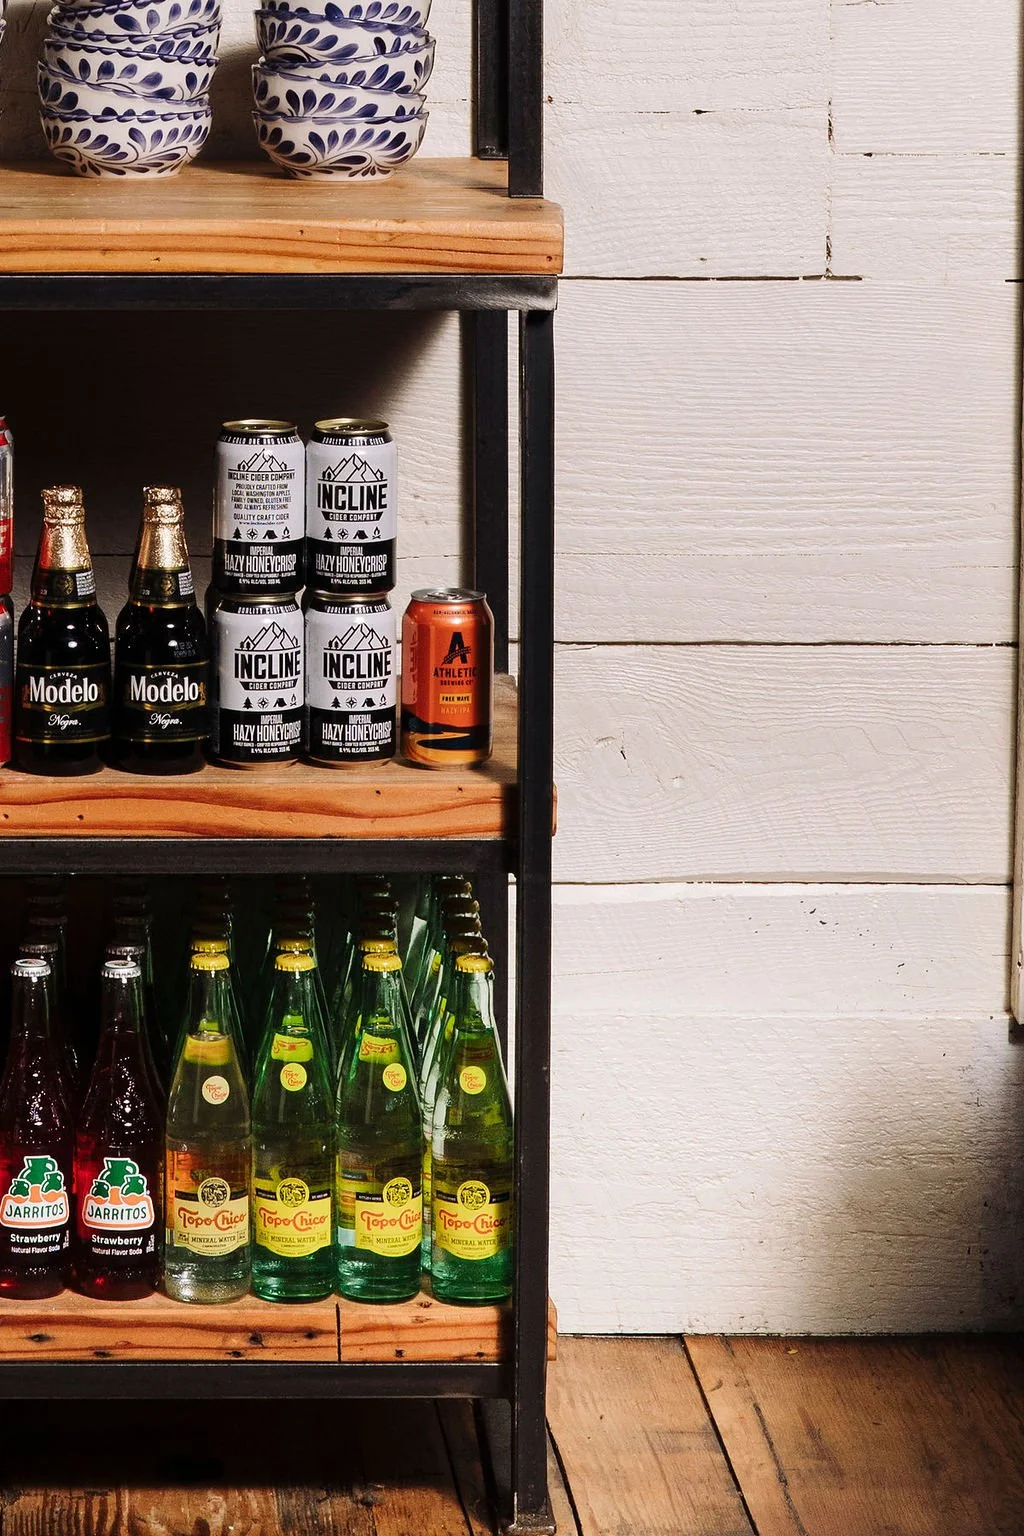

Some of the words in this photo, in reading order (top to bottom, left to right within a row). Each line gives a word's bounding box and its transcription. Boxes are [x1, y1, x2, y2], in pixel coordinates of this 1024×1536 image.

[228, 472, 249, 481] INCLINE
[271, 472, 295, 481] COMPANY
[318, 483, 387, 511] INCLINE
[250, 546, 273, 555] IMPERIAL
[340, 546, 363, 556] IMPERIAL
[225, 553, 244, 571] HAZY
[246, 554, 296, 573] HONEYCRISP
[316, 554, 335, 571] HAZY
[336, 554, 387, 573] HONEYCRISP
[235, 650, 300, 679] INCLINE
[324, 650, 391, 678] INCLINE
[49, 672, 78, 680] CERVEZA
[151, 671, 178, 679] CERVEZA
[433, 667, 477, 678] ATHLETIC
[30, 675, 98, 703] Modelo
[130, 675, 198, 702] Modelo
[249, 682, 267, 690] CIDER
[269, 681, 294, 689] COMPANY
[358, 680, 383, 689] COMPANY
[261, 714, 283, 724] IMPERIAL
[349, 714, 371, 724] IMPERIAL
[233, 724, 255, 741] HAZY
[257, 720, 301, 741] HONEYCRISP
[322, 723, 343, 741] HAZY
[345, 720, 392, 741] HONEYCRISP
[5, 1204, 64, 1220] JARRITOS
[88, 1205, 147, 1220] JARRITOS
[10, 1233, 60, 1243] Strawberry
[92, 1234, 143, 1246] Strawberry
[270, 1235, 295, 1243] MINERAL
